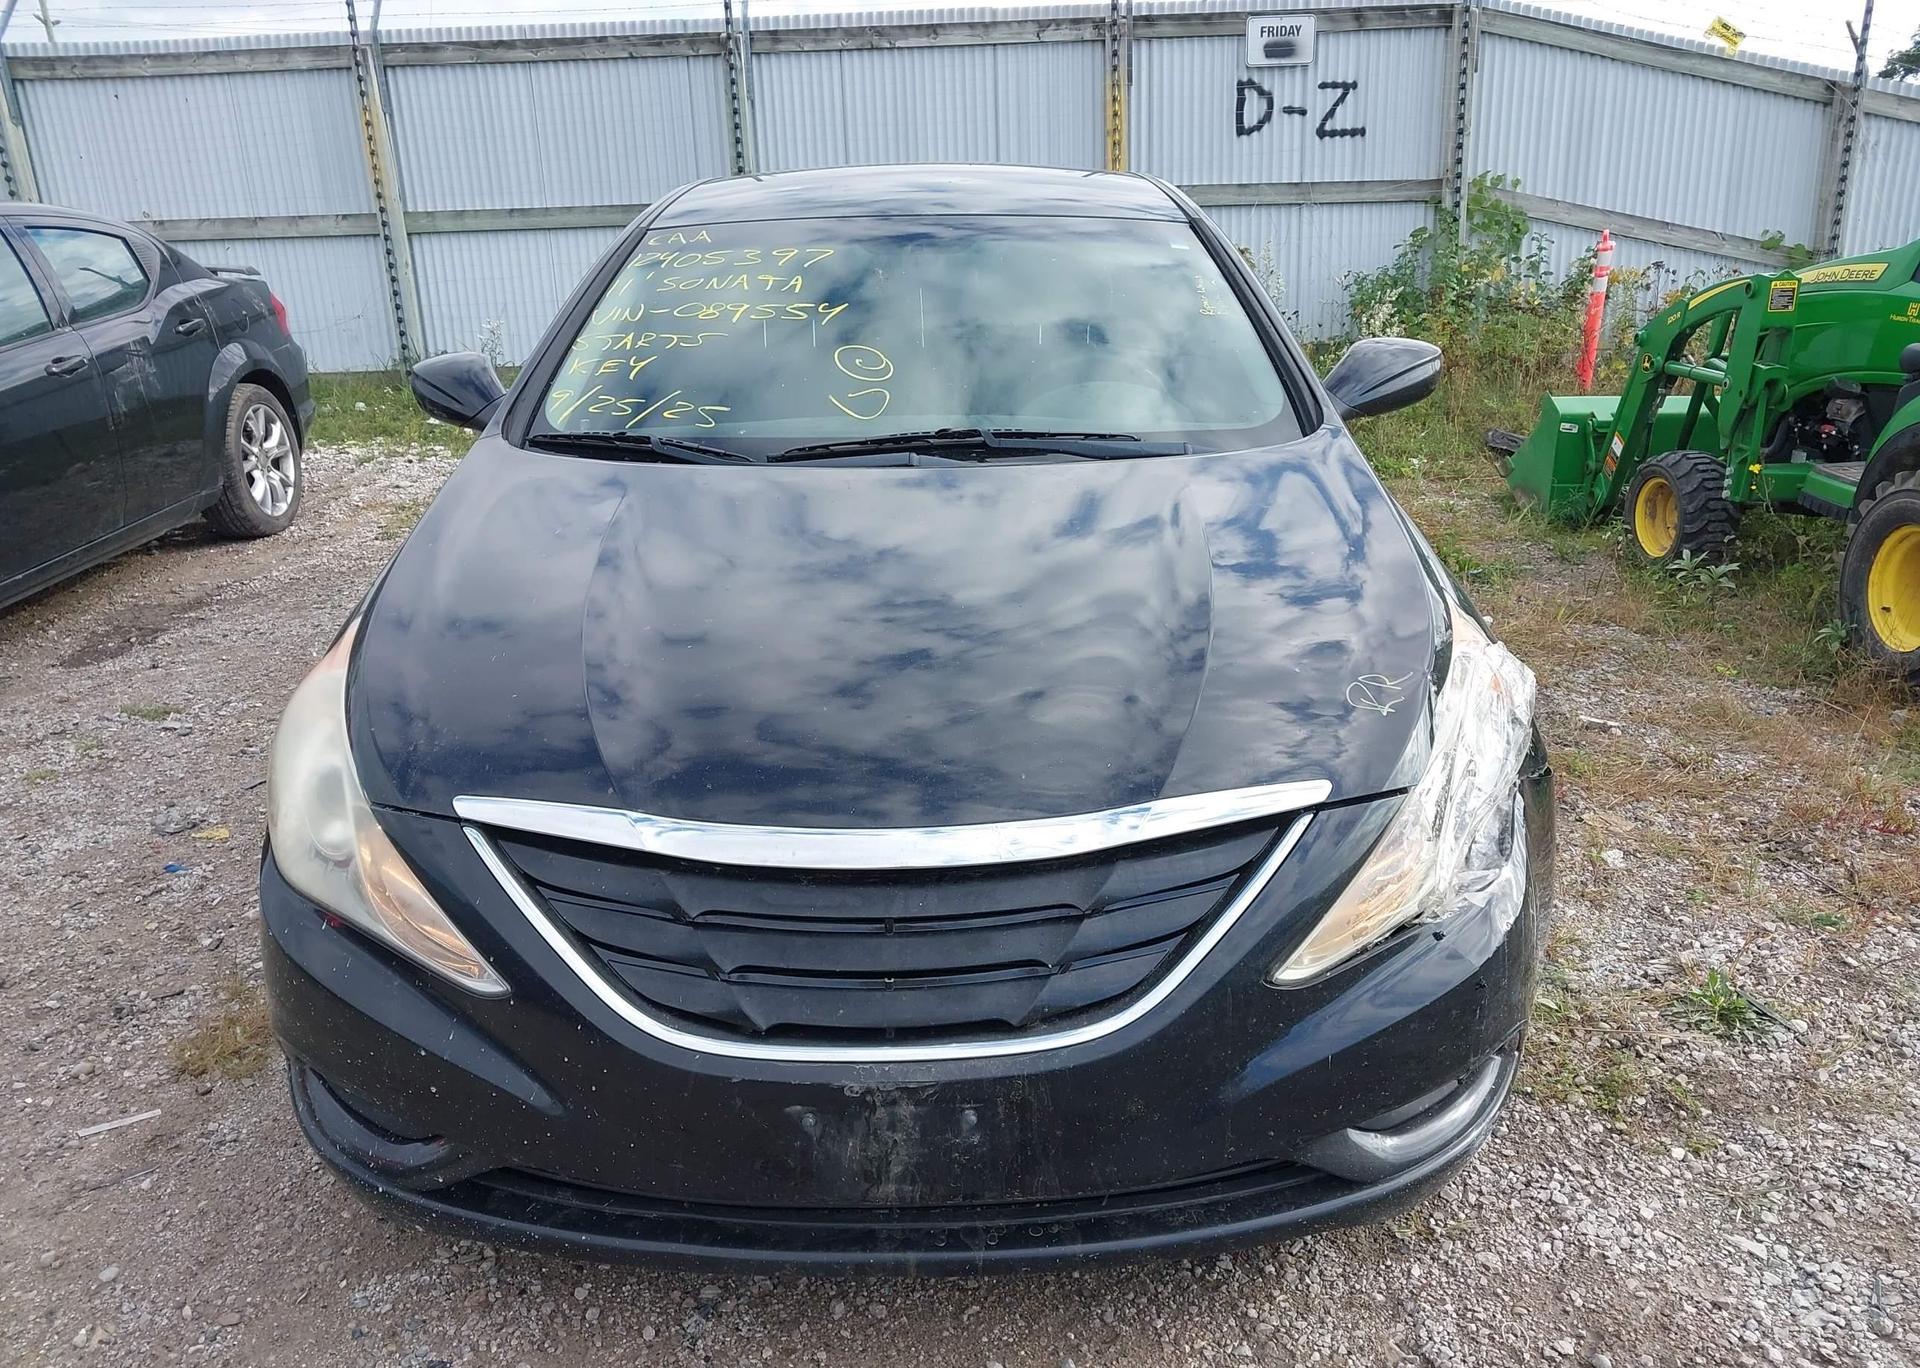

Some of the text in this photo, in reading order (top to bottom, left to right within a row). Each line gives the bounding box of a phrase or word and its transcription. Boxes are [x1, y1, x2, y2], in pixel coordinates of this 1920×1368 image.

[1260, 25, 1303, 38] FRIDAY
[1235, 78, 1366, 140] D-Z
[656, 274, 804, 294] SONATA
[1811, 269, 1878, 281] JOHN DEERE
[572, 332, 729, 351] STARTS
[568, 355, 657, 381] KEY
[551, 385, 731, 429] 9/25/25
